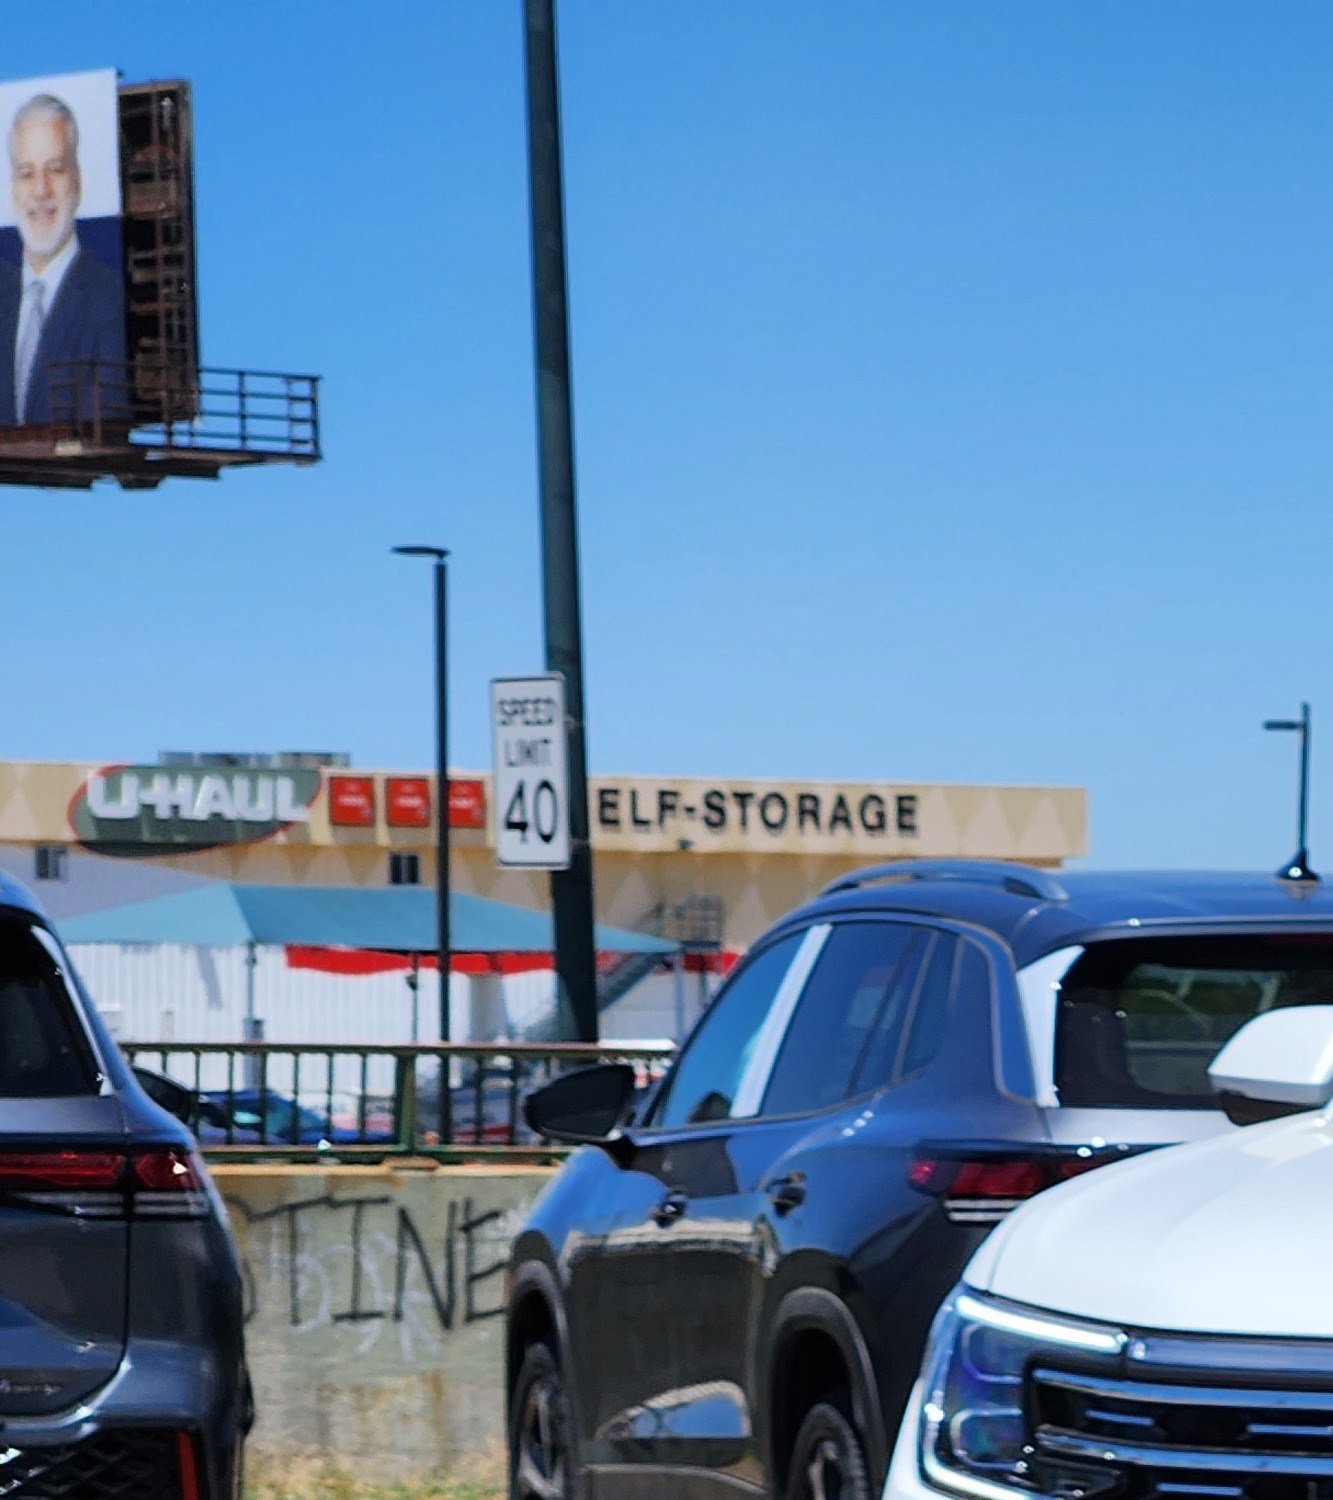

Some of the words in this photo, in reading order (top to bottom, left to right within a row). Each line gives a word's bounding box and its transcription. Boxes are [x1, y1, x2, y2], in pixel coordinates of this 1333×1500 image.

[498, 696, 556, 727] SPEED
[504, 737, 553, 769] LIMIT
[504, 776, 559, 845] 40
[597, 787, 919, 837] ELF-STORAGE
